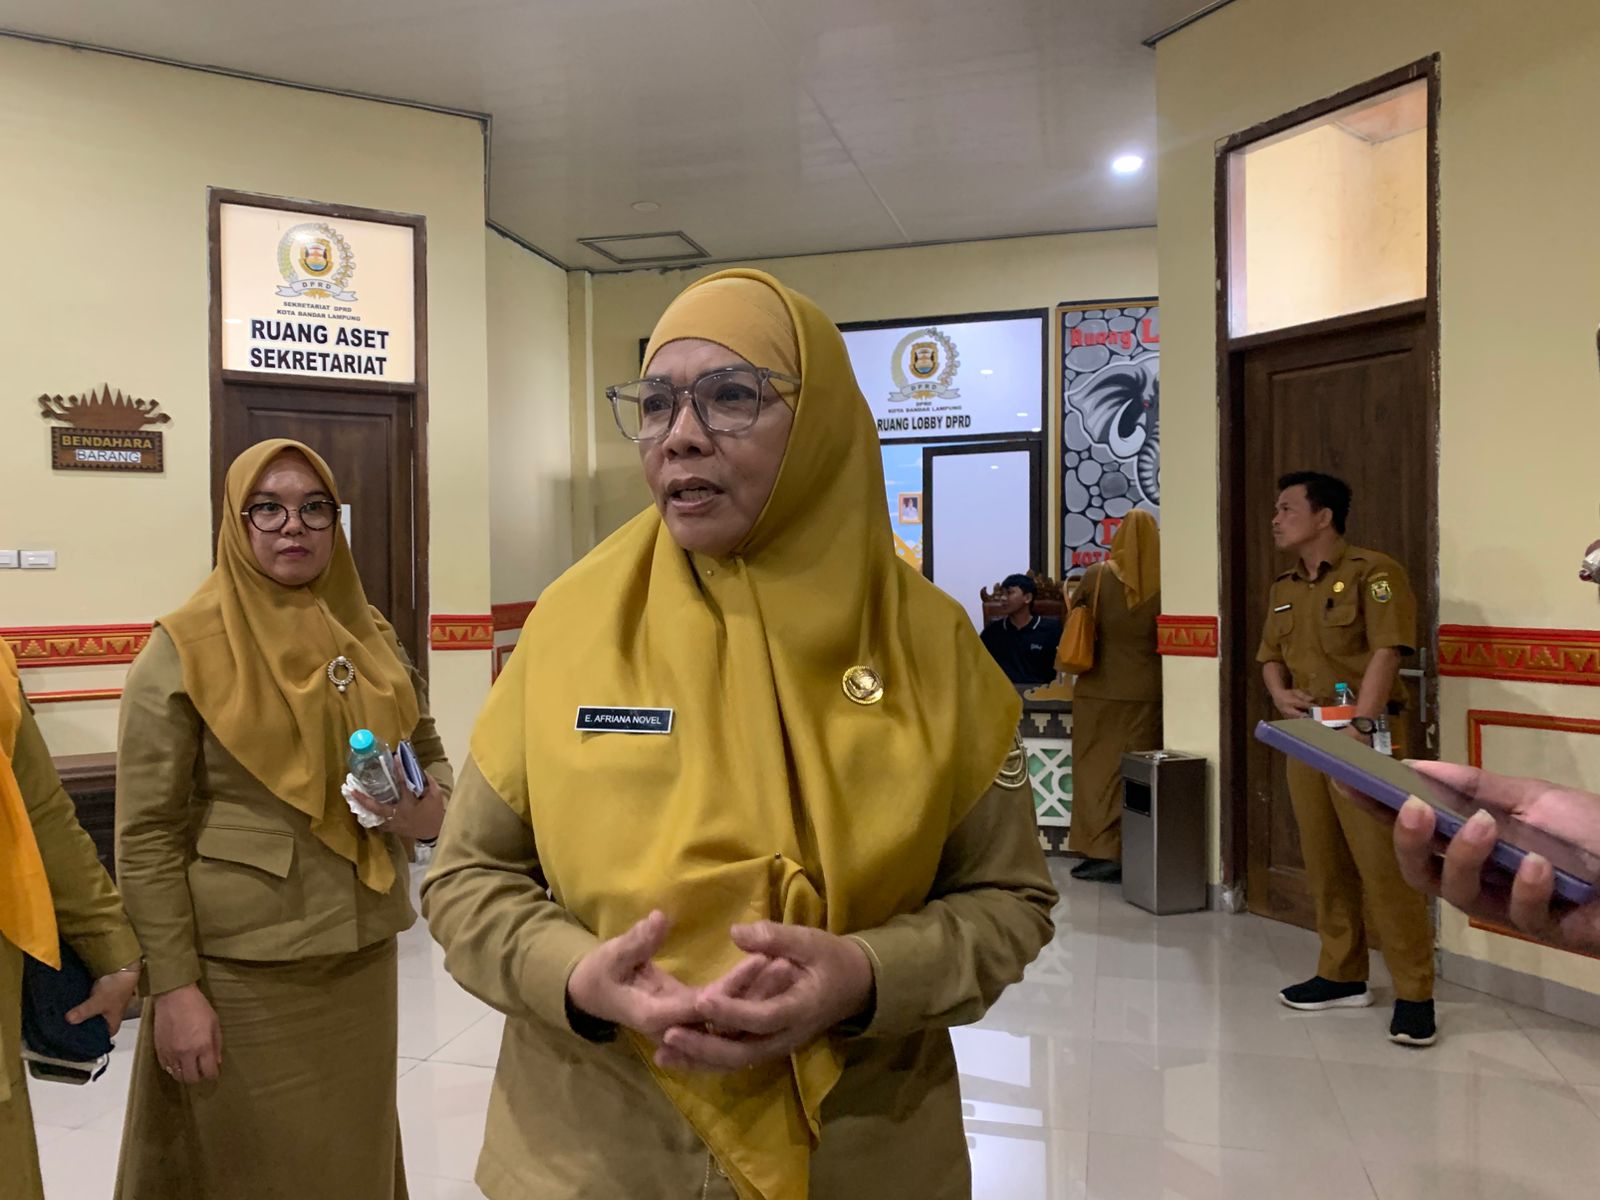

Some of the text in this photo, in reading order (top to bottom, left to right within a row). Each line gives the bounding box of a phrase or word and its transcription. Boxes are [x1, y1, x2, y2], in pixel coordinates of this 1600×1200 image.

[302, 281, 331, 289] DPRD
[283, 301, 331, 310] SEKRETARIAT
[251, 319, 389, 350] RUANG ASET
[1071, 328, 1131, 349] Ruang
[250, 348, 387, 375] SEKRETARIAT
[877, 415, 971, 432] RUANG LOBBY DPRD
[62, 435, 152, 449] BENDAHARA
[77, 450, 140, 463] BARANG
[584, 714, 661, 725] E. AFRIANA NOVEL
